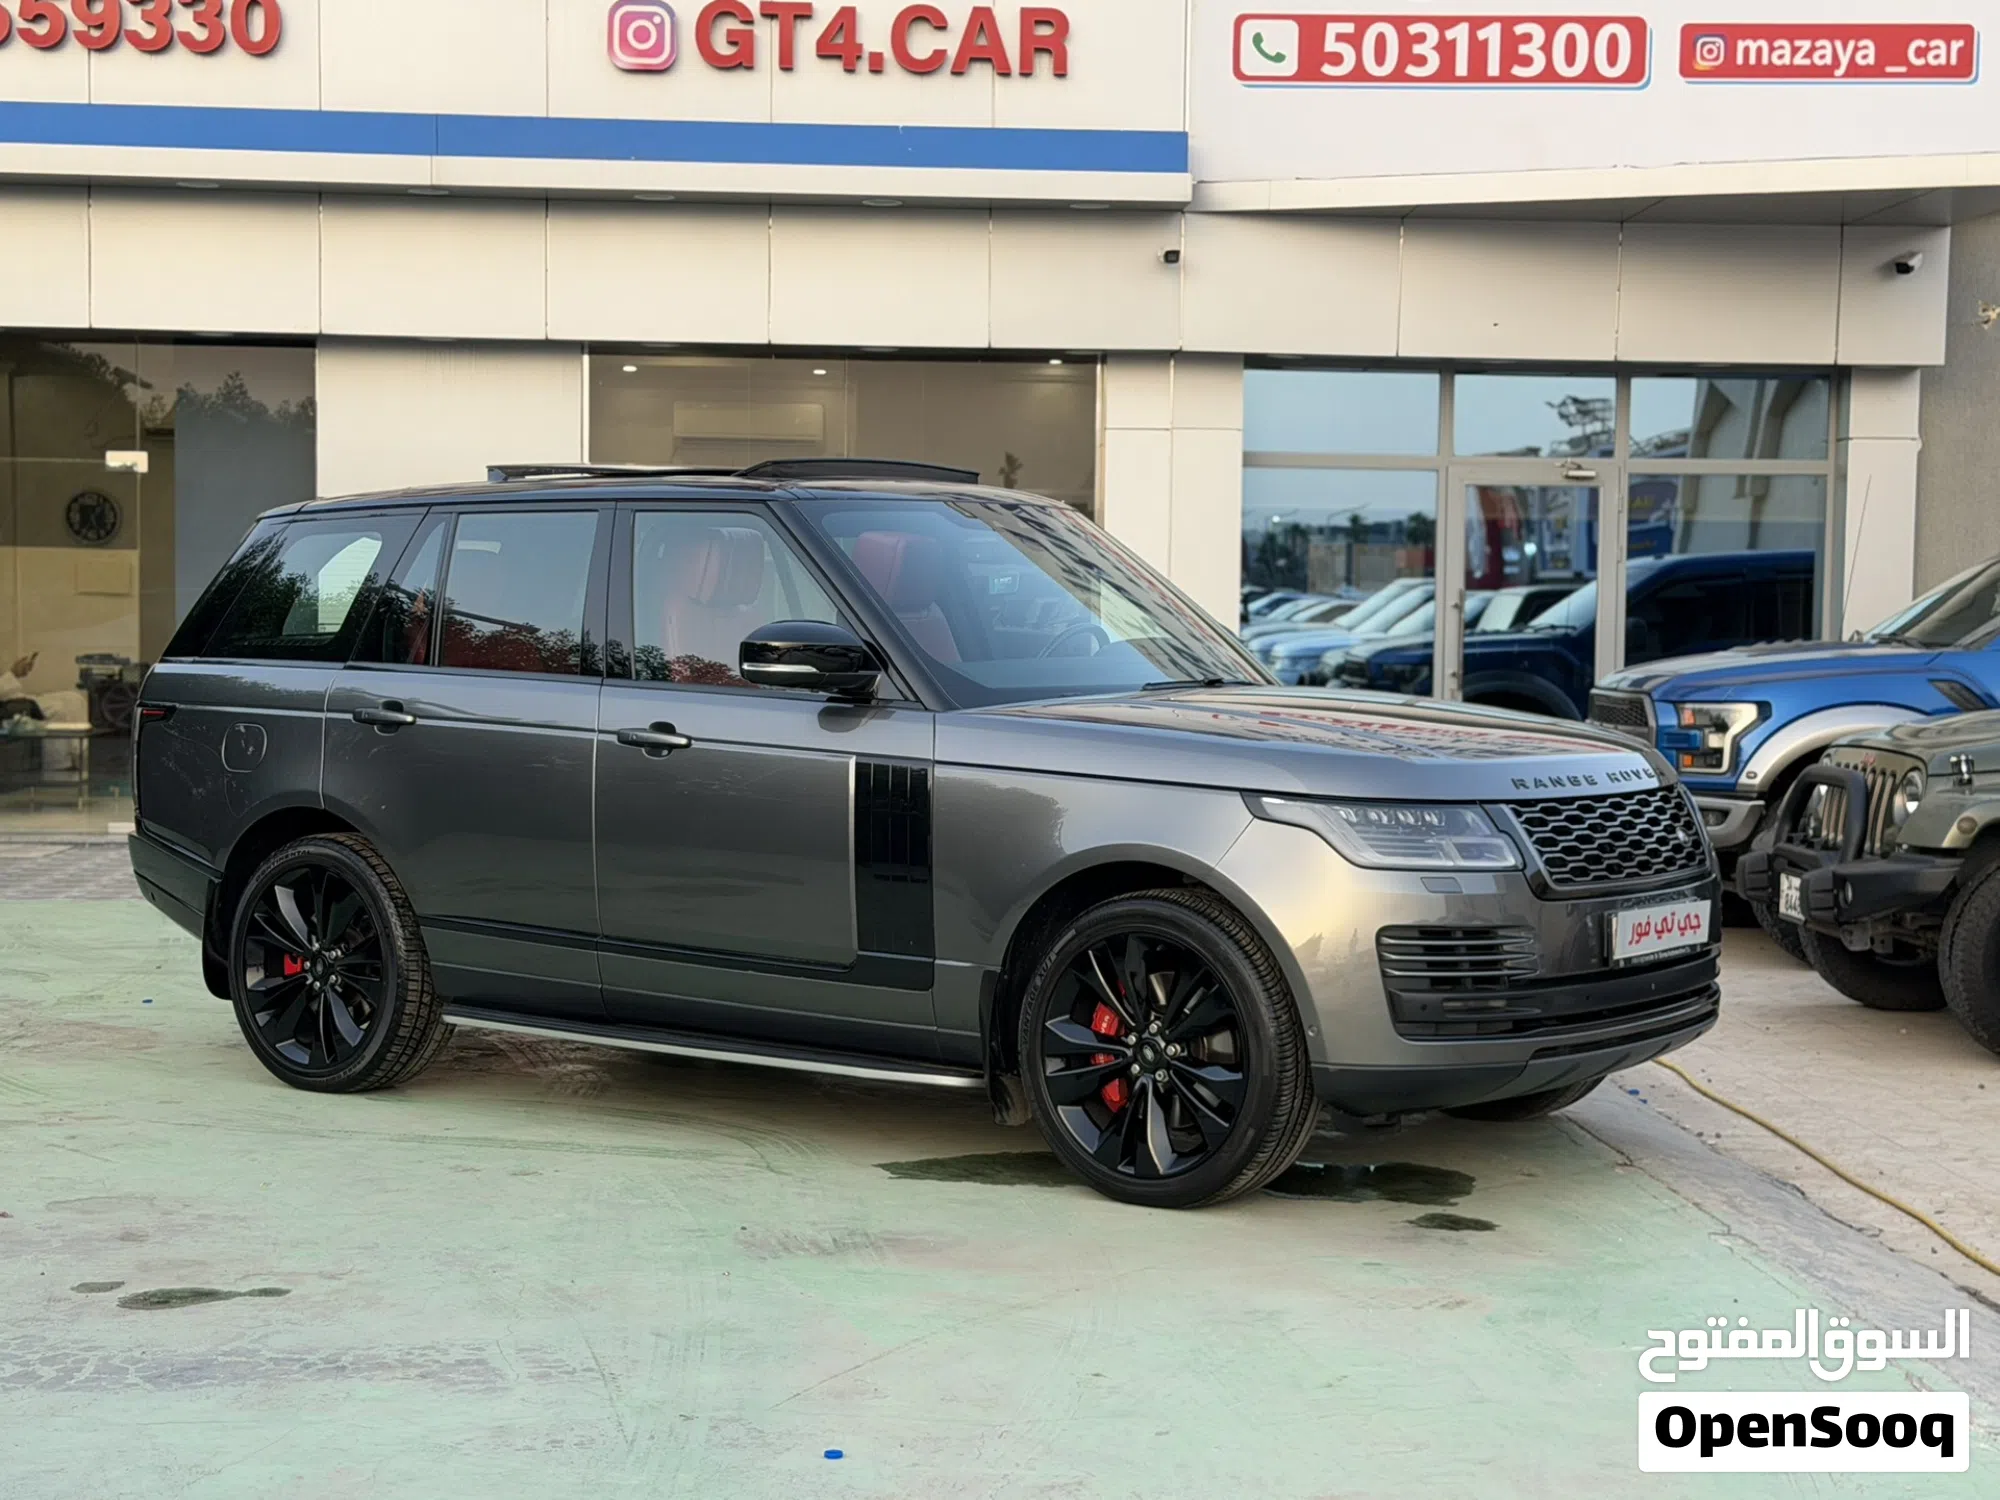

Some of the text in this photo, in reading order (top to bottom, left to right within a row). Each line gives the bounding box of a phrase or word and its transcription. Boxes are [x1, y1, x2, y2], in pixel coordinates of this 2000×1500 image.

[0, 0, 282, 56] 59330
[695, 0, 1070, 76] GT4.CAR
[1320, 21, 1632, 79] 50311300
[1735, 37, 1876, 77] mazaya
[1510, 774, 1599, 790] RANGE
[1627, 910, 1702, 947] جي تي فور
